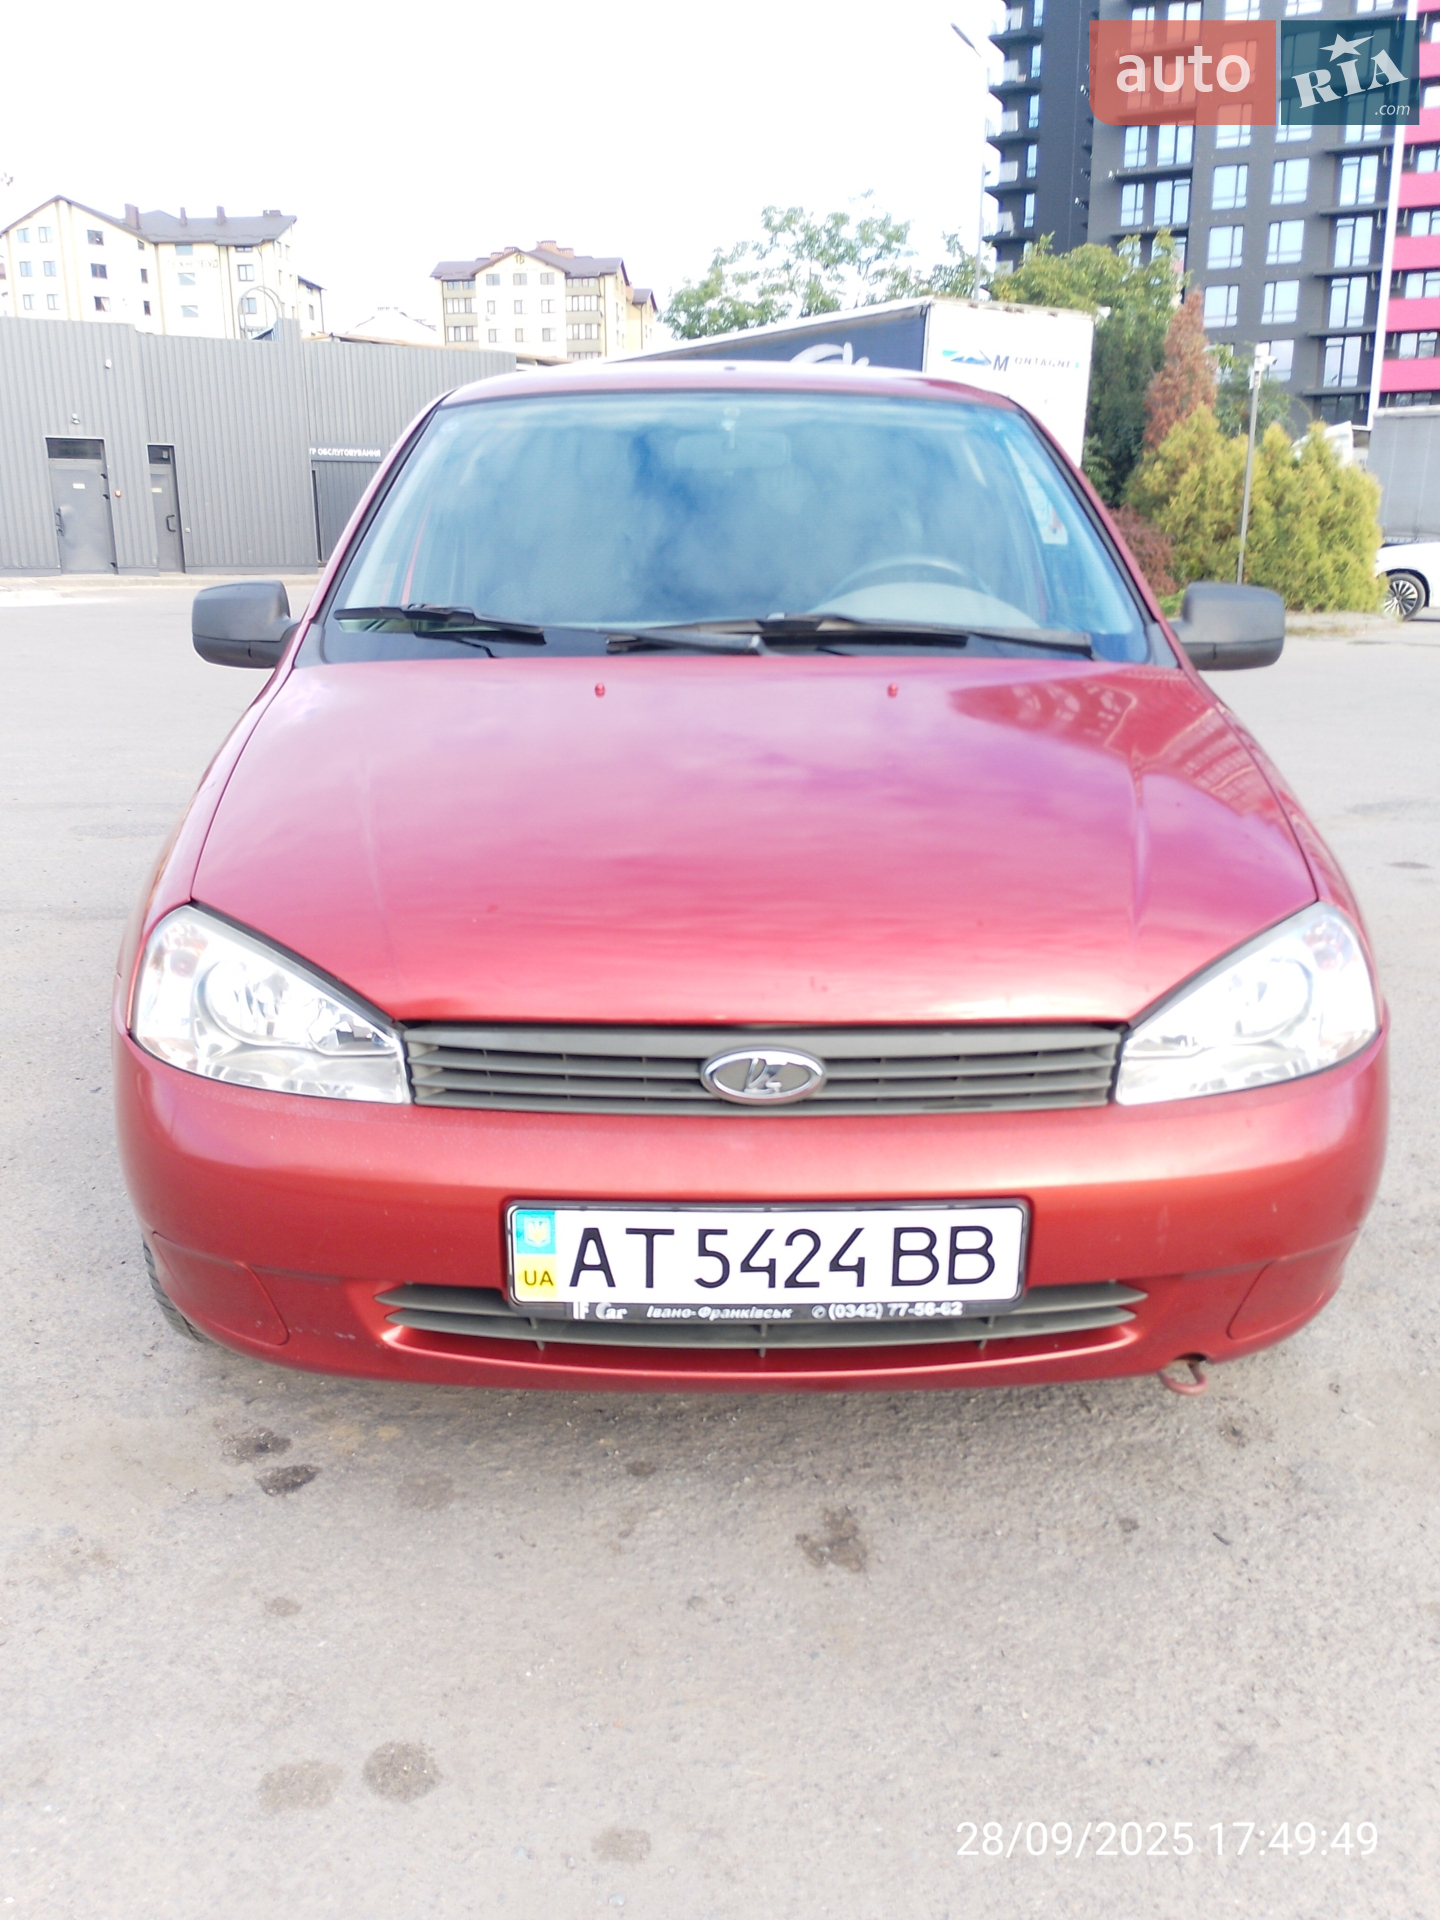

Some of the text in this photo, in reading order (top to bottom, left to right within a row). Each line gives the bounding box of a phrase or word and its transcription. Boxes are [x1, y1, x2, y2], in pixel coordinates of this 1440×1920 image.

[318, 448, 381, 457] ОБСЛУГОВУВАННЯ
[569, 1225, 996, 1289] AT 5424 BB
[523, 1269, 554, 1287] UA
[595, 1301, 628, 1320] Car
[646, 1305, 793, 1322] Івано-Франківськ
[828, 1302, 883, 1321] (0342)
